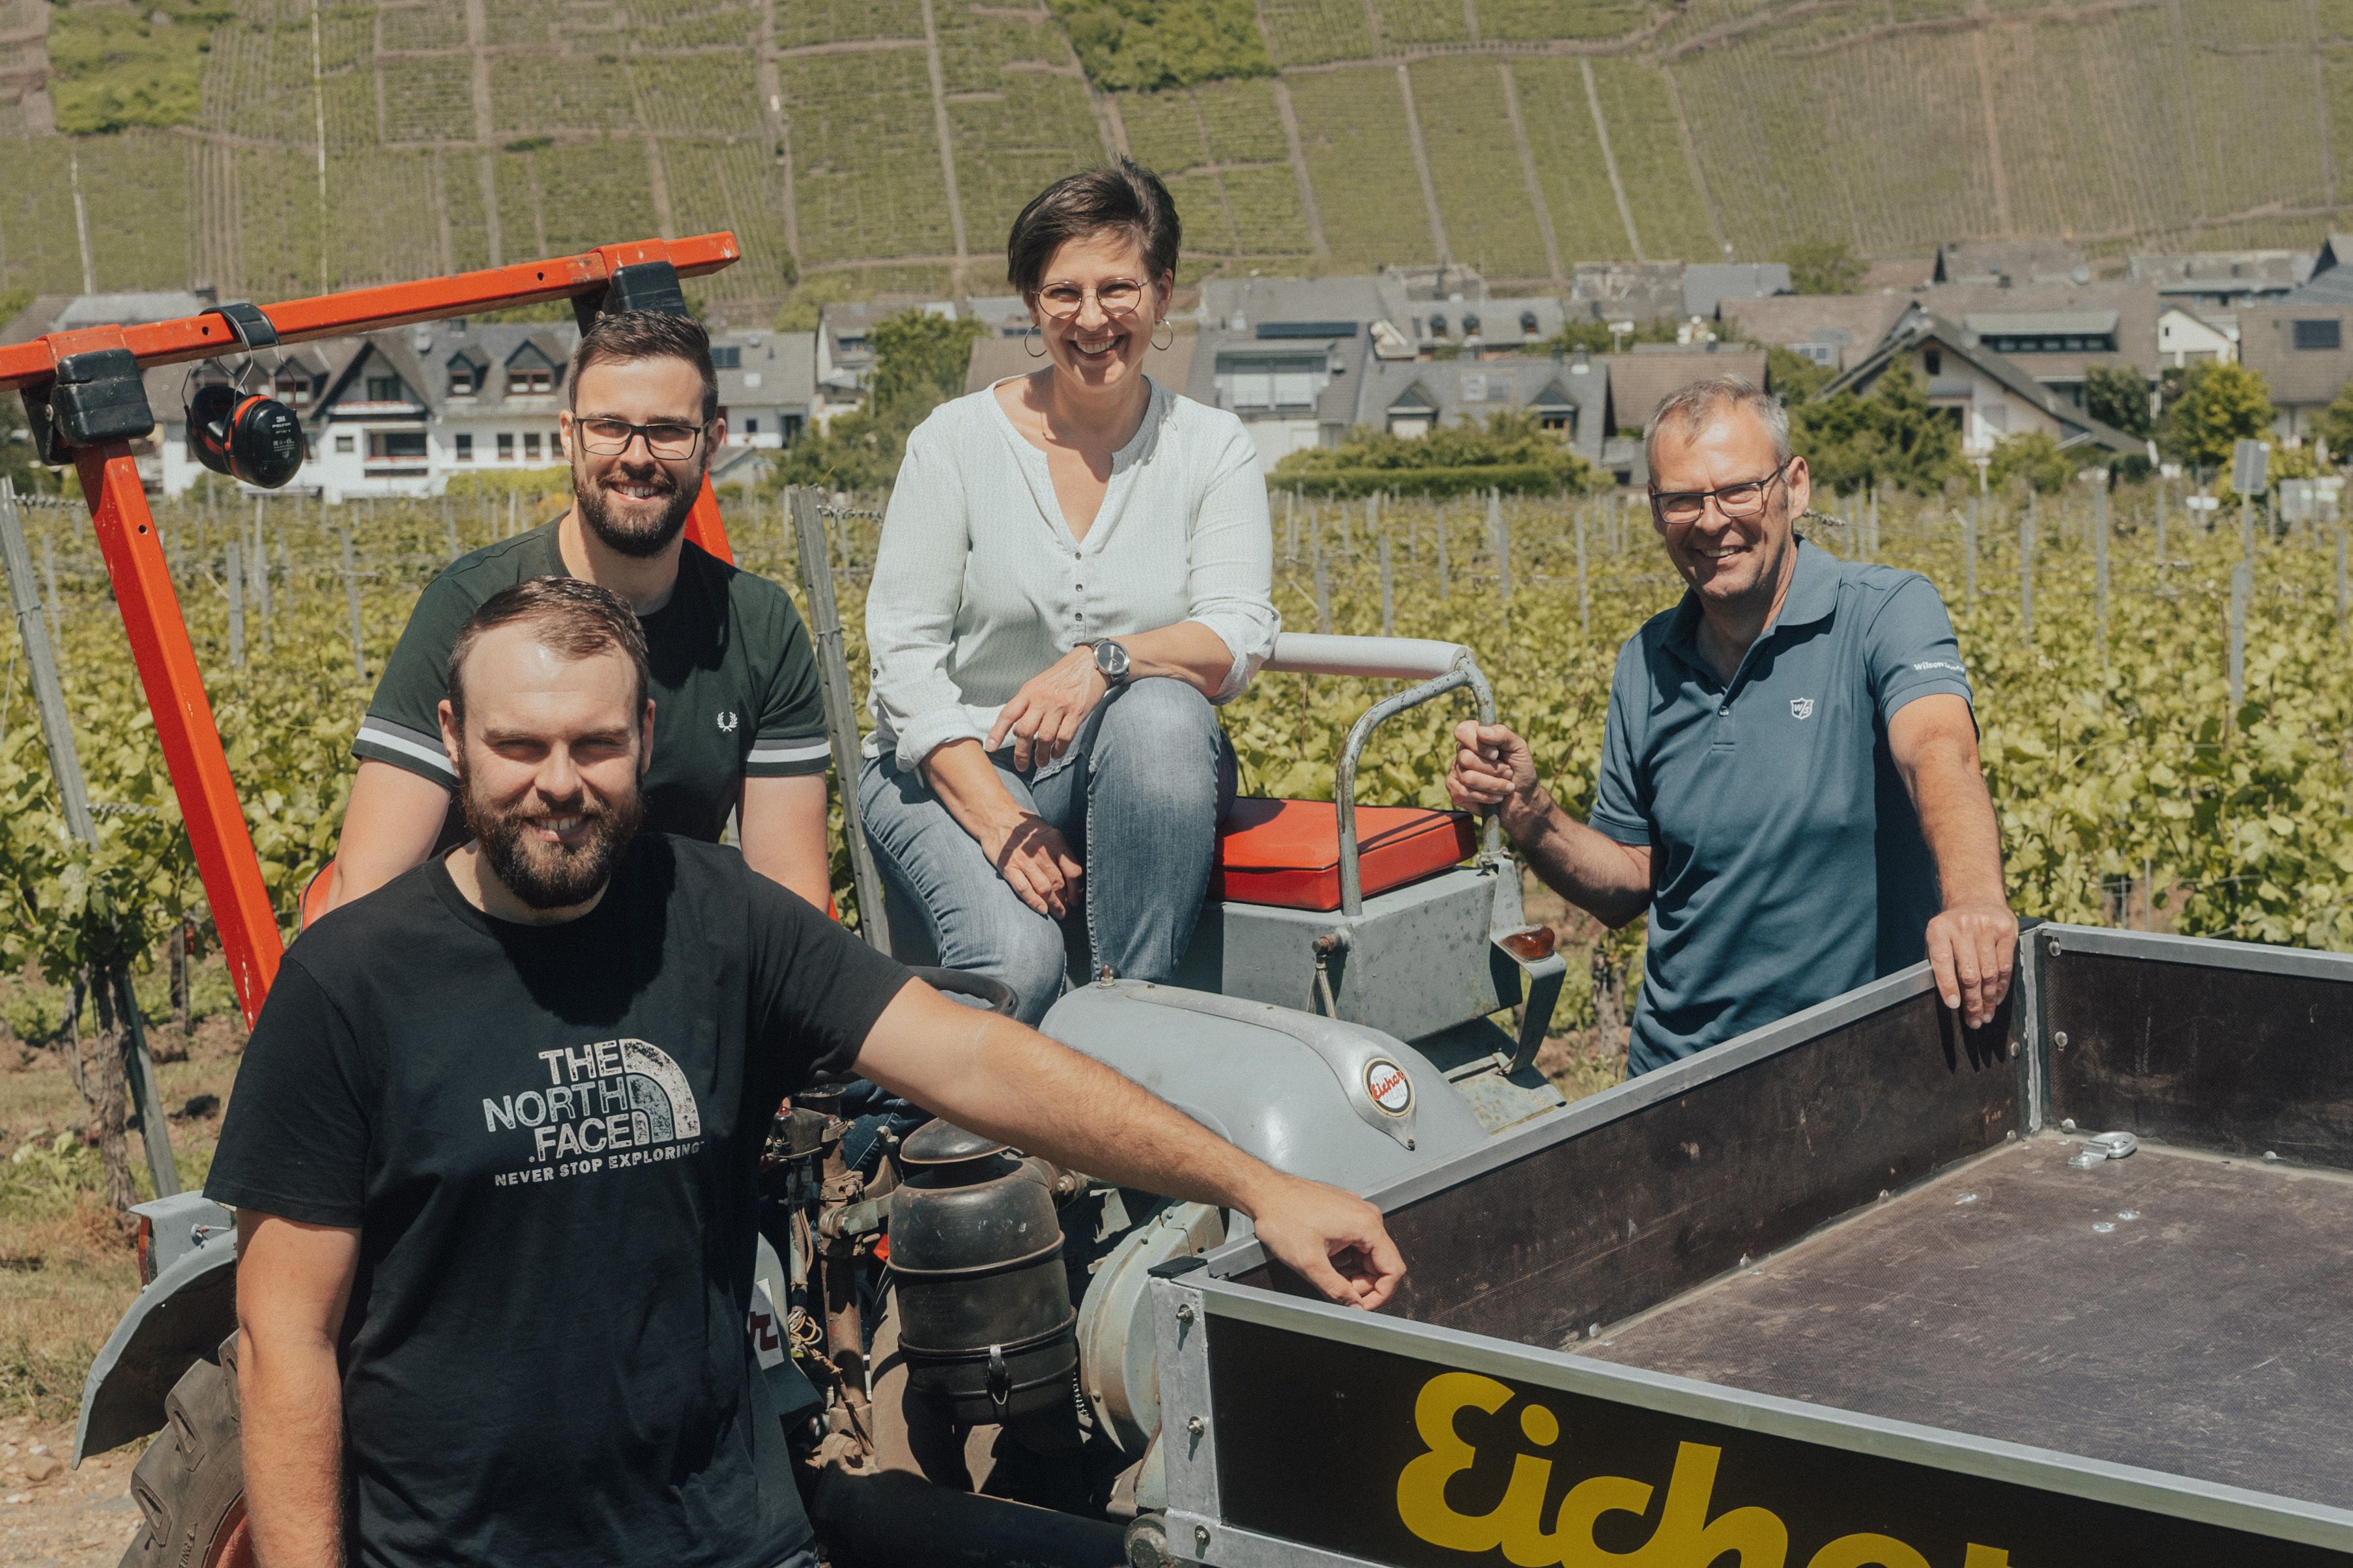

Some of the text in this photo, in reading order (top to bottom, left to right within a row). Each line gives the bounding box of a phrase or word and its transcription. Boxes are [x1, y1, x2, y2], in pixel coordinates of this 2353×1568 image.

[1913, 661, 1944, 671] Wilson
[538, 1040, 623, 1085] THE
[482, 1076, 628, 1132] NORTH
[1370, 1070, 1406, 1101] Eicher
[534, 1113, 633, 1162] FACE
[495, 1141, 700, 1186] NEVER STOP EXPLORING
